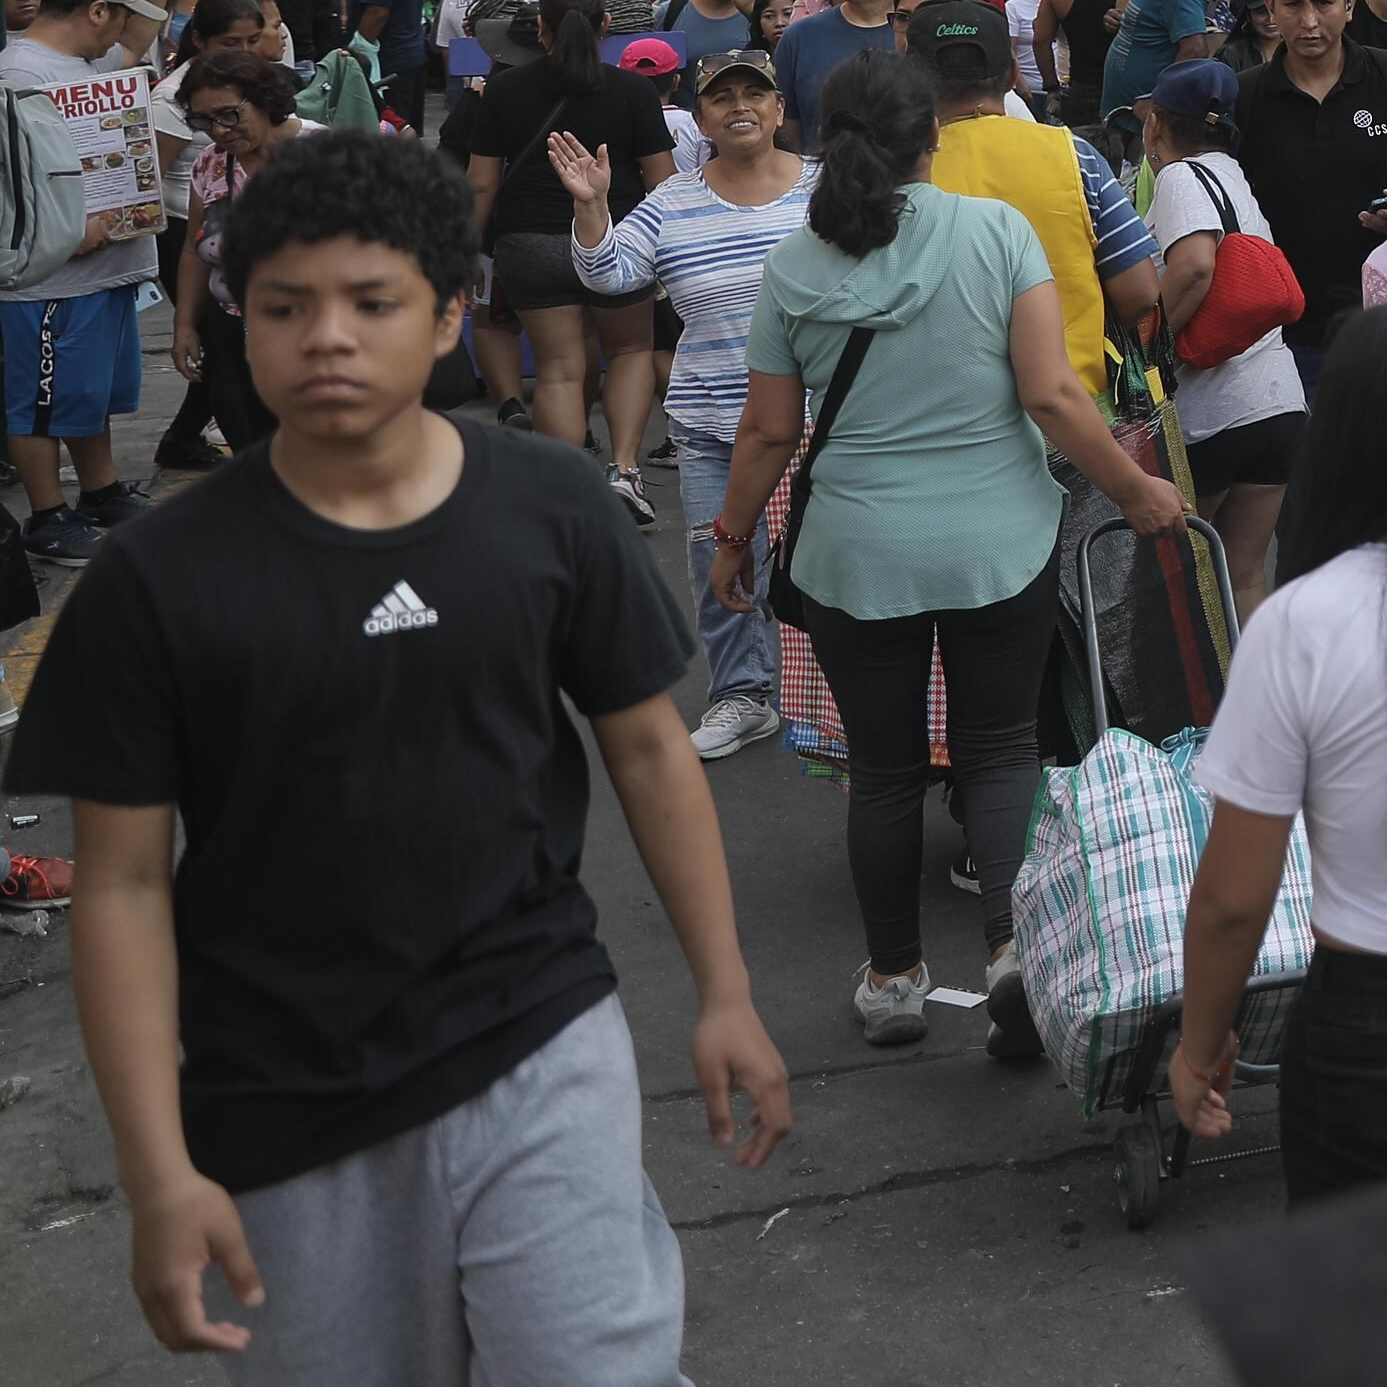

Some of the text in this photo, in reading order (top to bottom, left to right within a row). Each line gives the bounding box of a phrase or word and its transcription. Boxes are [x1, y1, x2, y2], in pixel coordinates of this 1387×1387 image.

[936, 23, 978, 38] Celtics
[46, 76, 137, 107] MENU
[1367, 123, 1387, 137] CCS
[365, 607, 439, 637] adidas
